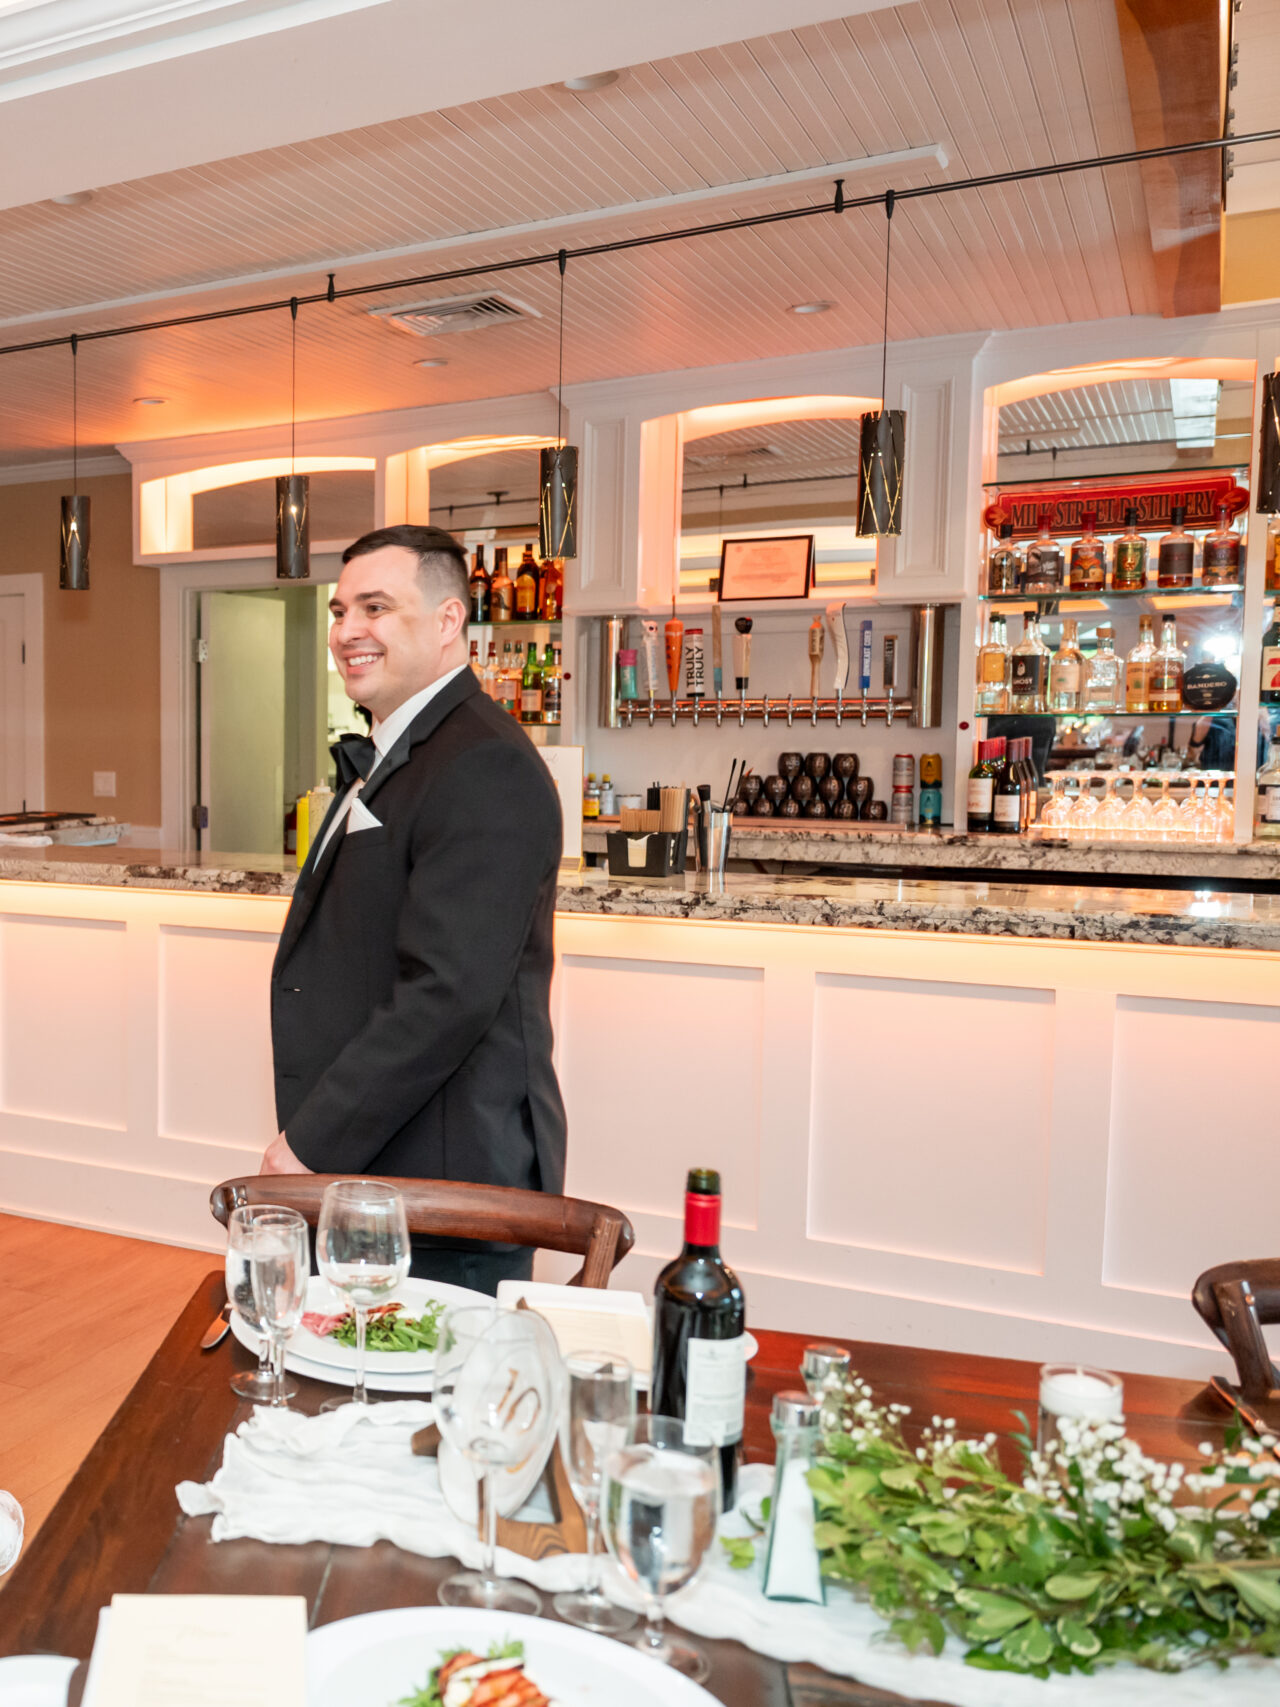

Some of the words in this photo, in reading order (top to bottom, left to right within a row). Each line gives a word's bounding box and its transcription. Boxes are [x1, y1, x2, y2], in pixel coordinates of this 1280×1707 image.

[686, 646, 695, 688] TRULY
[695, 646, 704, 687] TRULY
[497, 1367, 542, 1436] 10
